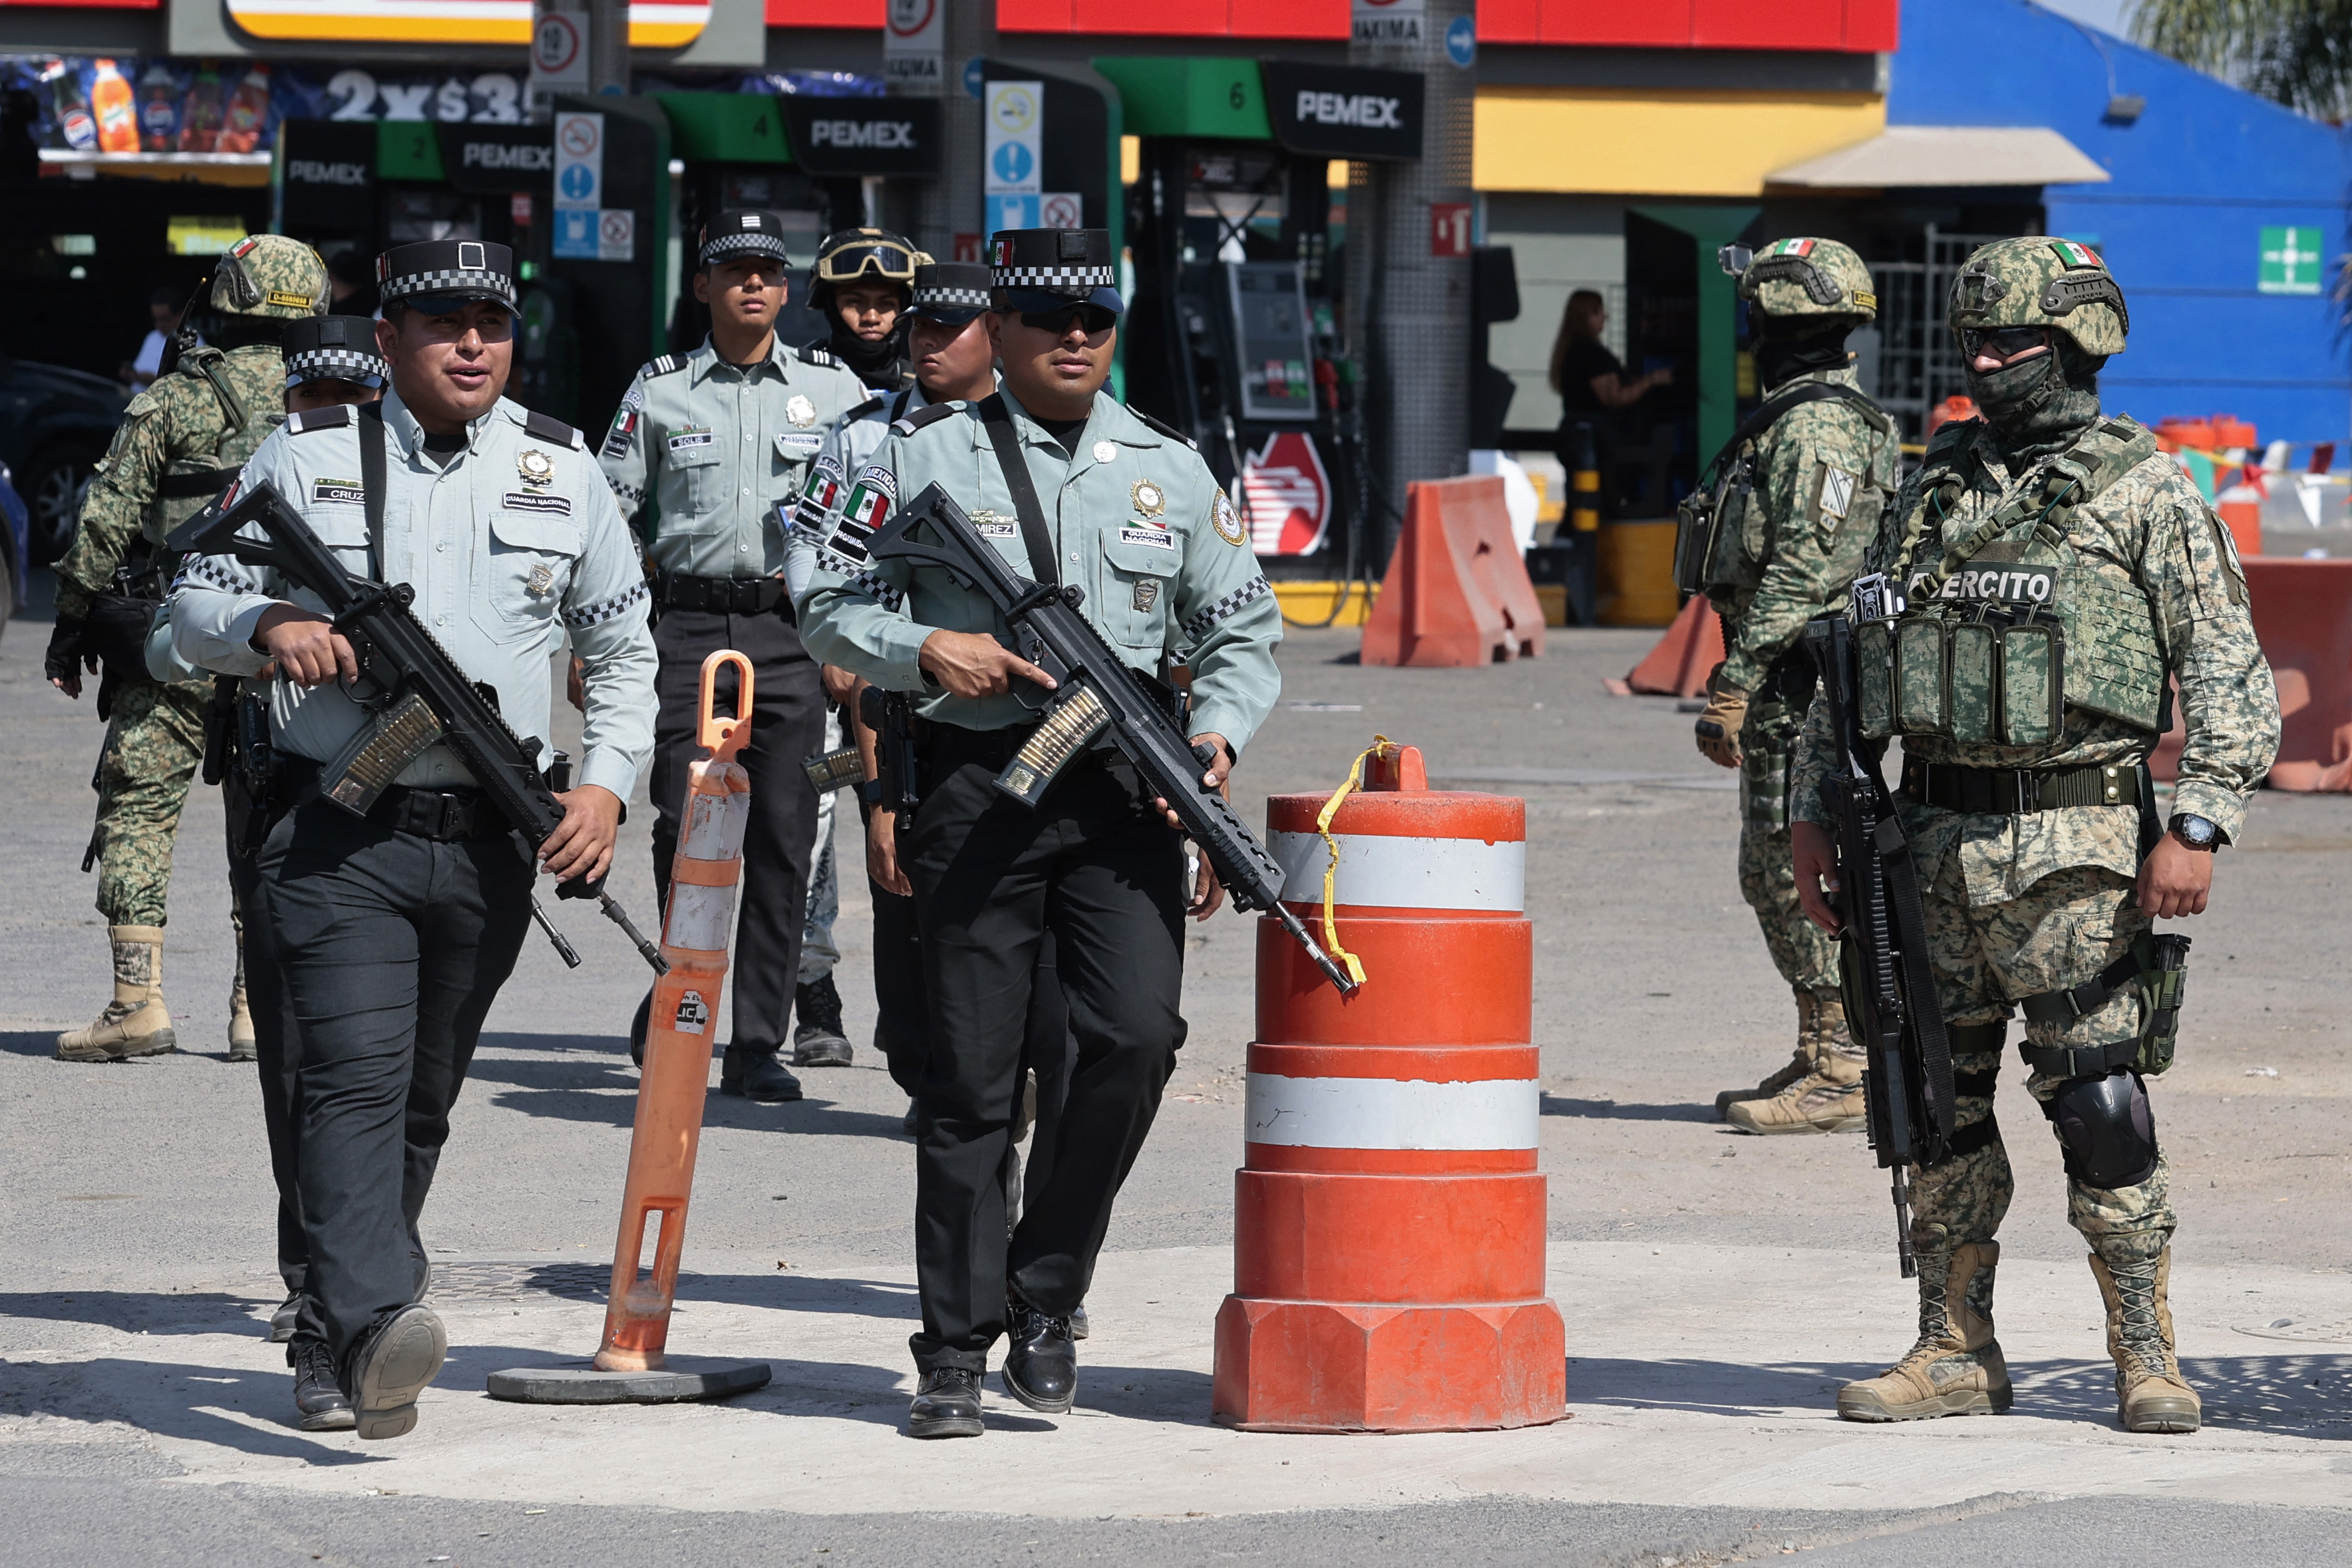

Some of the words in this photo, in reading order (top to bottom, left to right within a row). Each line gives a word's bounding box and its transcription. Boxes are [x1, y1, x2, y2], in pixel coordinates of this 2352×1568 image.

[1230, 81, 1246, 110] 6
[1297, 90, 1400, 128] PEMEX
[753, 114, 768, 137] 4
[811, 120, 914, 148] PEMEX
[464, 142, 552, 170] PEMEX
[289, 160, 367, 185] PEMEX
[678, 436, 703, 446] SOLIS
[331, 490, 365, 500] CRUZ
[538, 499, 570, 509] NACIONAL
[975, 524, 1012, 534] MIREZ
[1128, 531, 1166, 540] GUARDIA
[1125, 536, 1170, 546] NACIONAL
[1908, 571, 2050, 600] EERCITO
